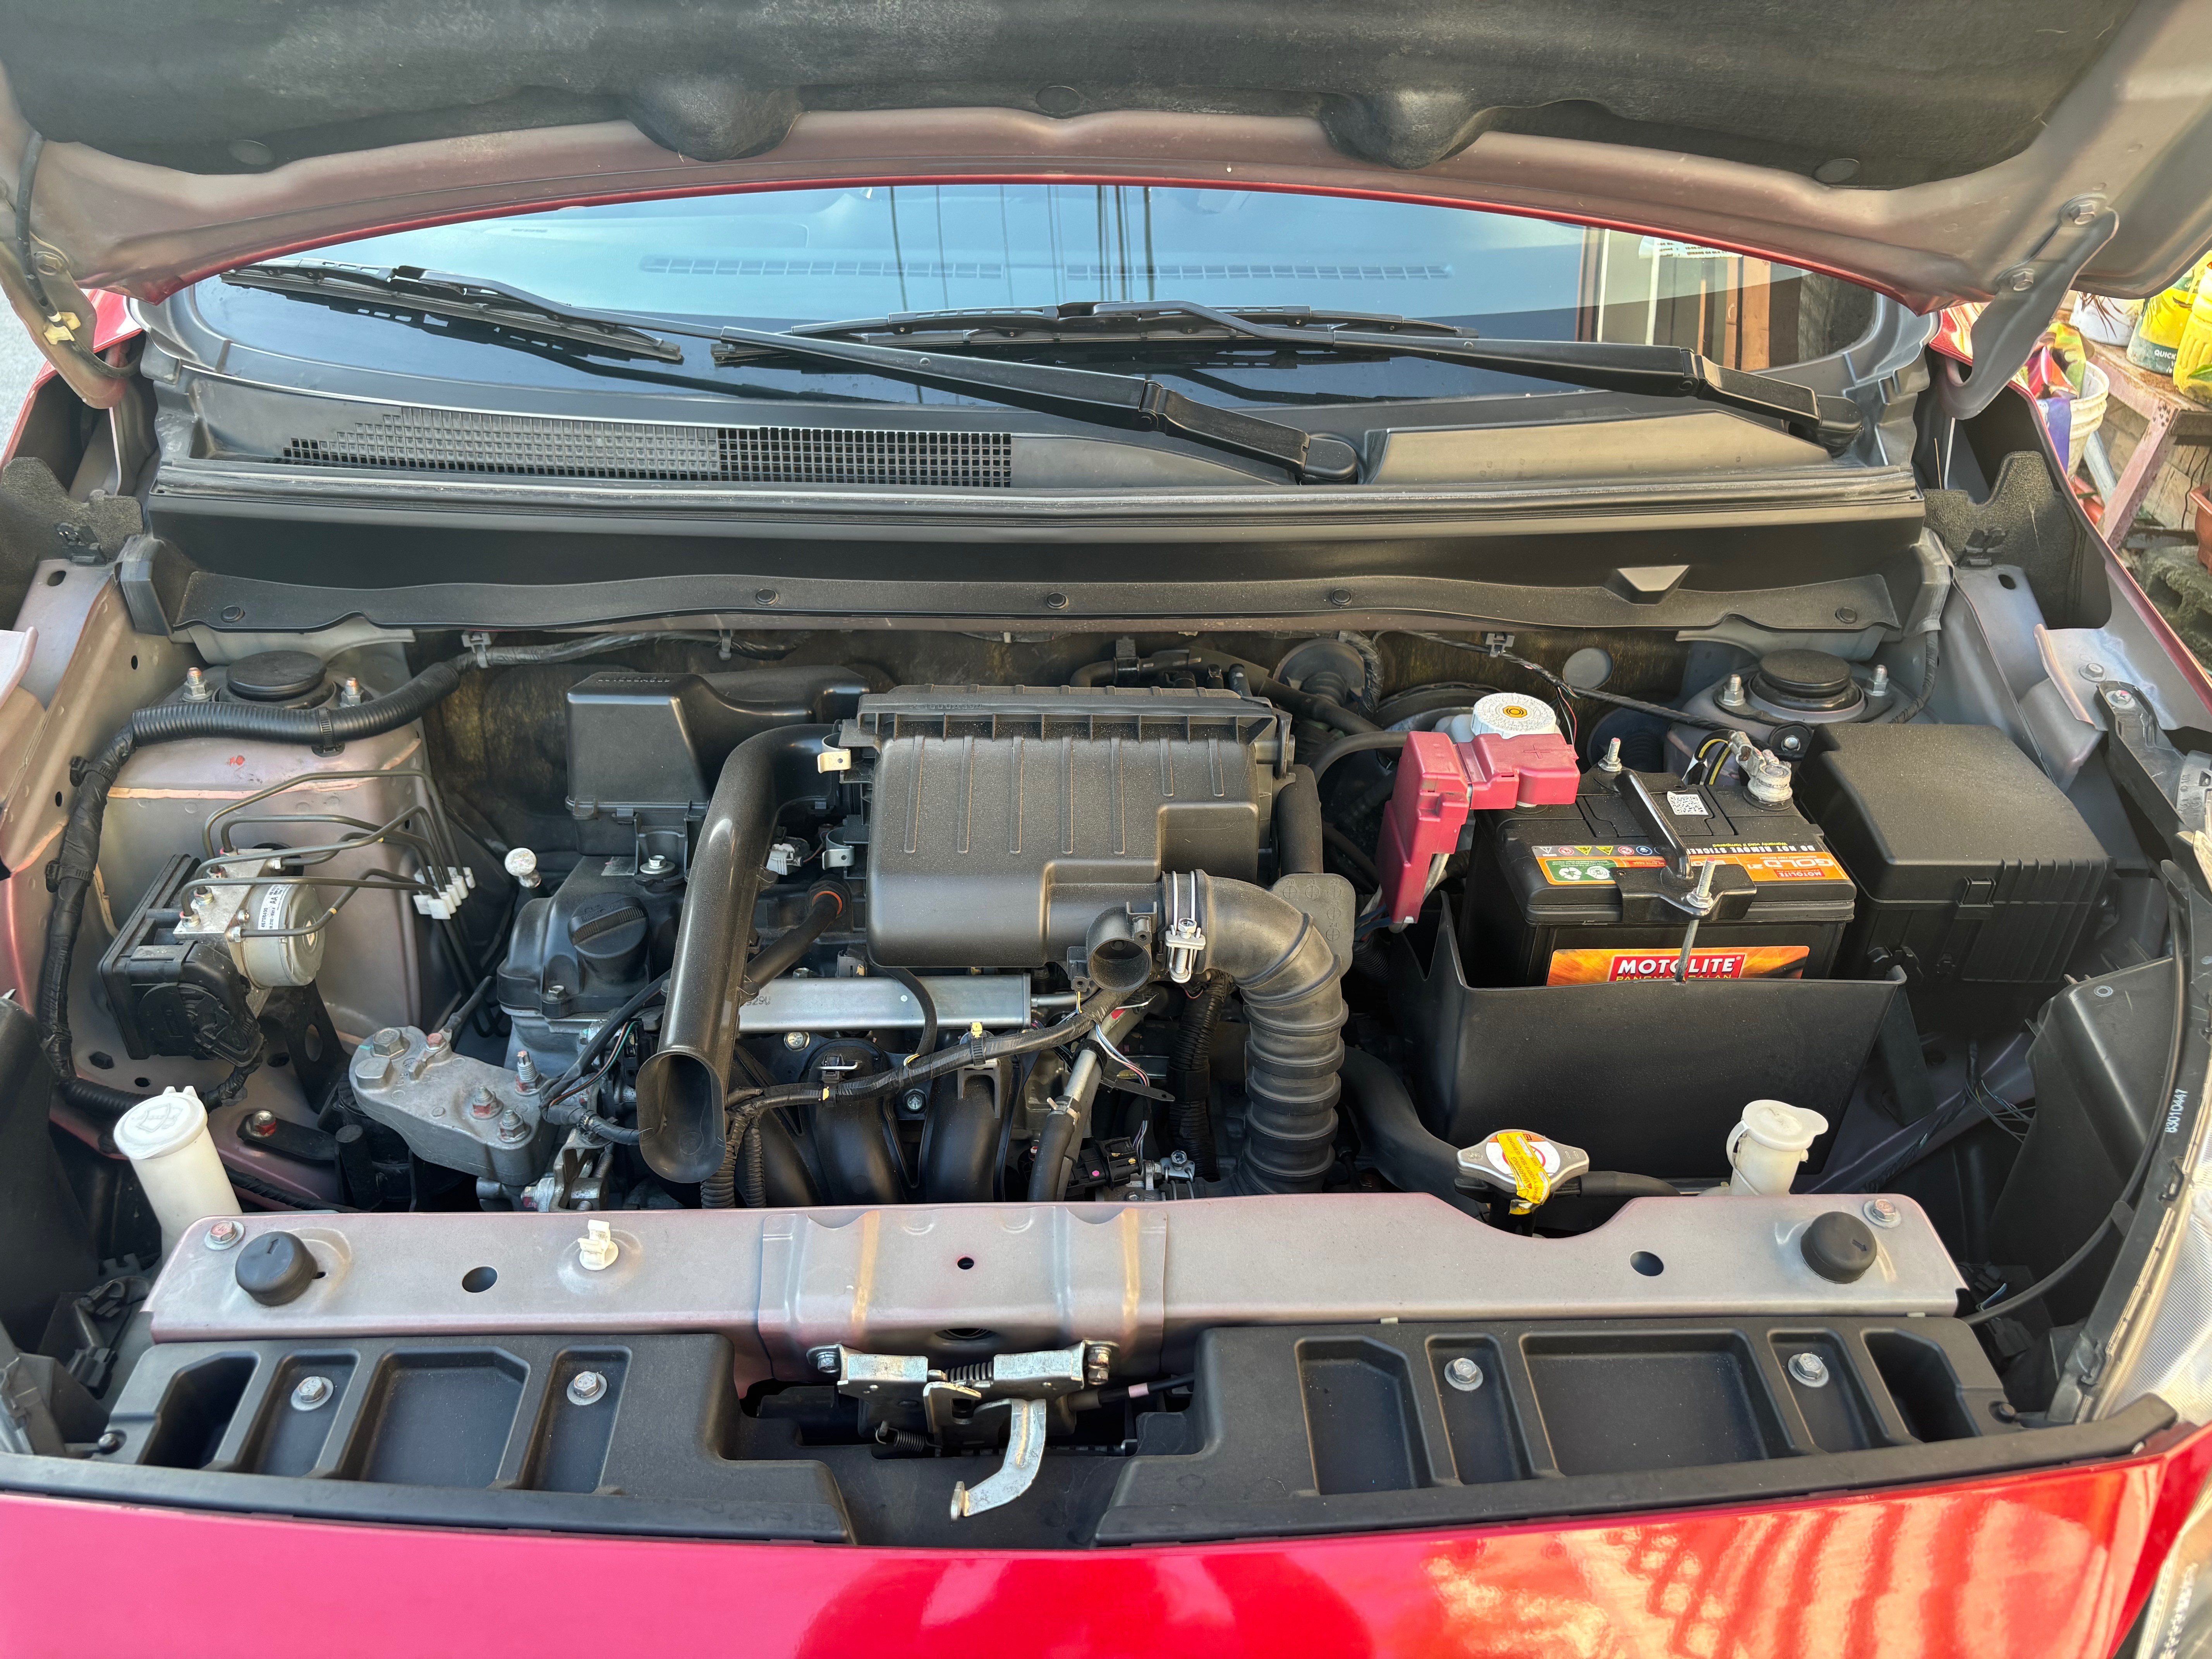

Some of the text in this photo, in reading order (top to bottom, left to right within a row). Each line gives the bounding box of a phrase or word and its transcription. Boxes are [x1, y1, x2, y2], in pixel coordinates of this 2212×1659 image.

[2154, 349, 2177, 361] QUICK
[1763, 858, 1832, 868] GOLD
[1511, 1156, 1531, 1184] WARNING
